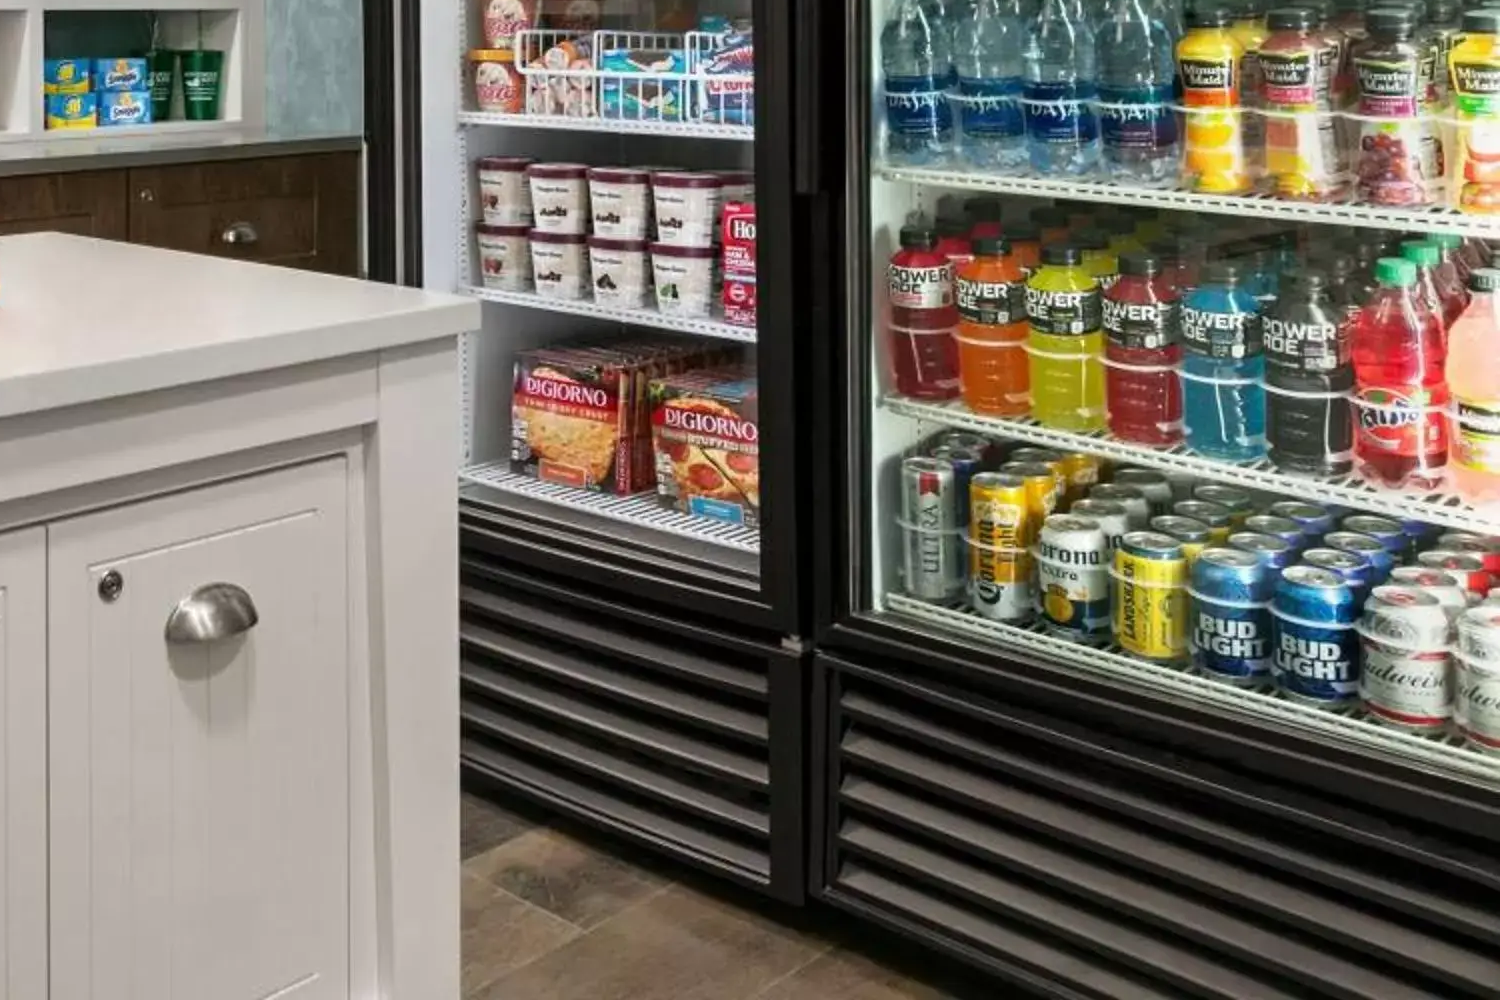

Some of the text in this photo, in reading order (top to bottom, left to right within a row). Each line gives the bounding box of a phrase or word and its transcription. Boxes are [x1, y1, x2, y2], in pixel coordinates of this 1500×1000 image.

[890, 267, 949, 283] POWER
[1263, 316, 1337, 341] POWER
[1200, 612, 1257, 639] BUD
[1194, 628, 1265, 658] LIGHT
[1281, 632, 1341, 661] BUD
[1277, 648, 1350, 681] LIGHT
